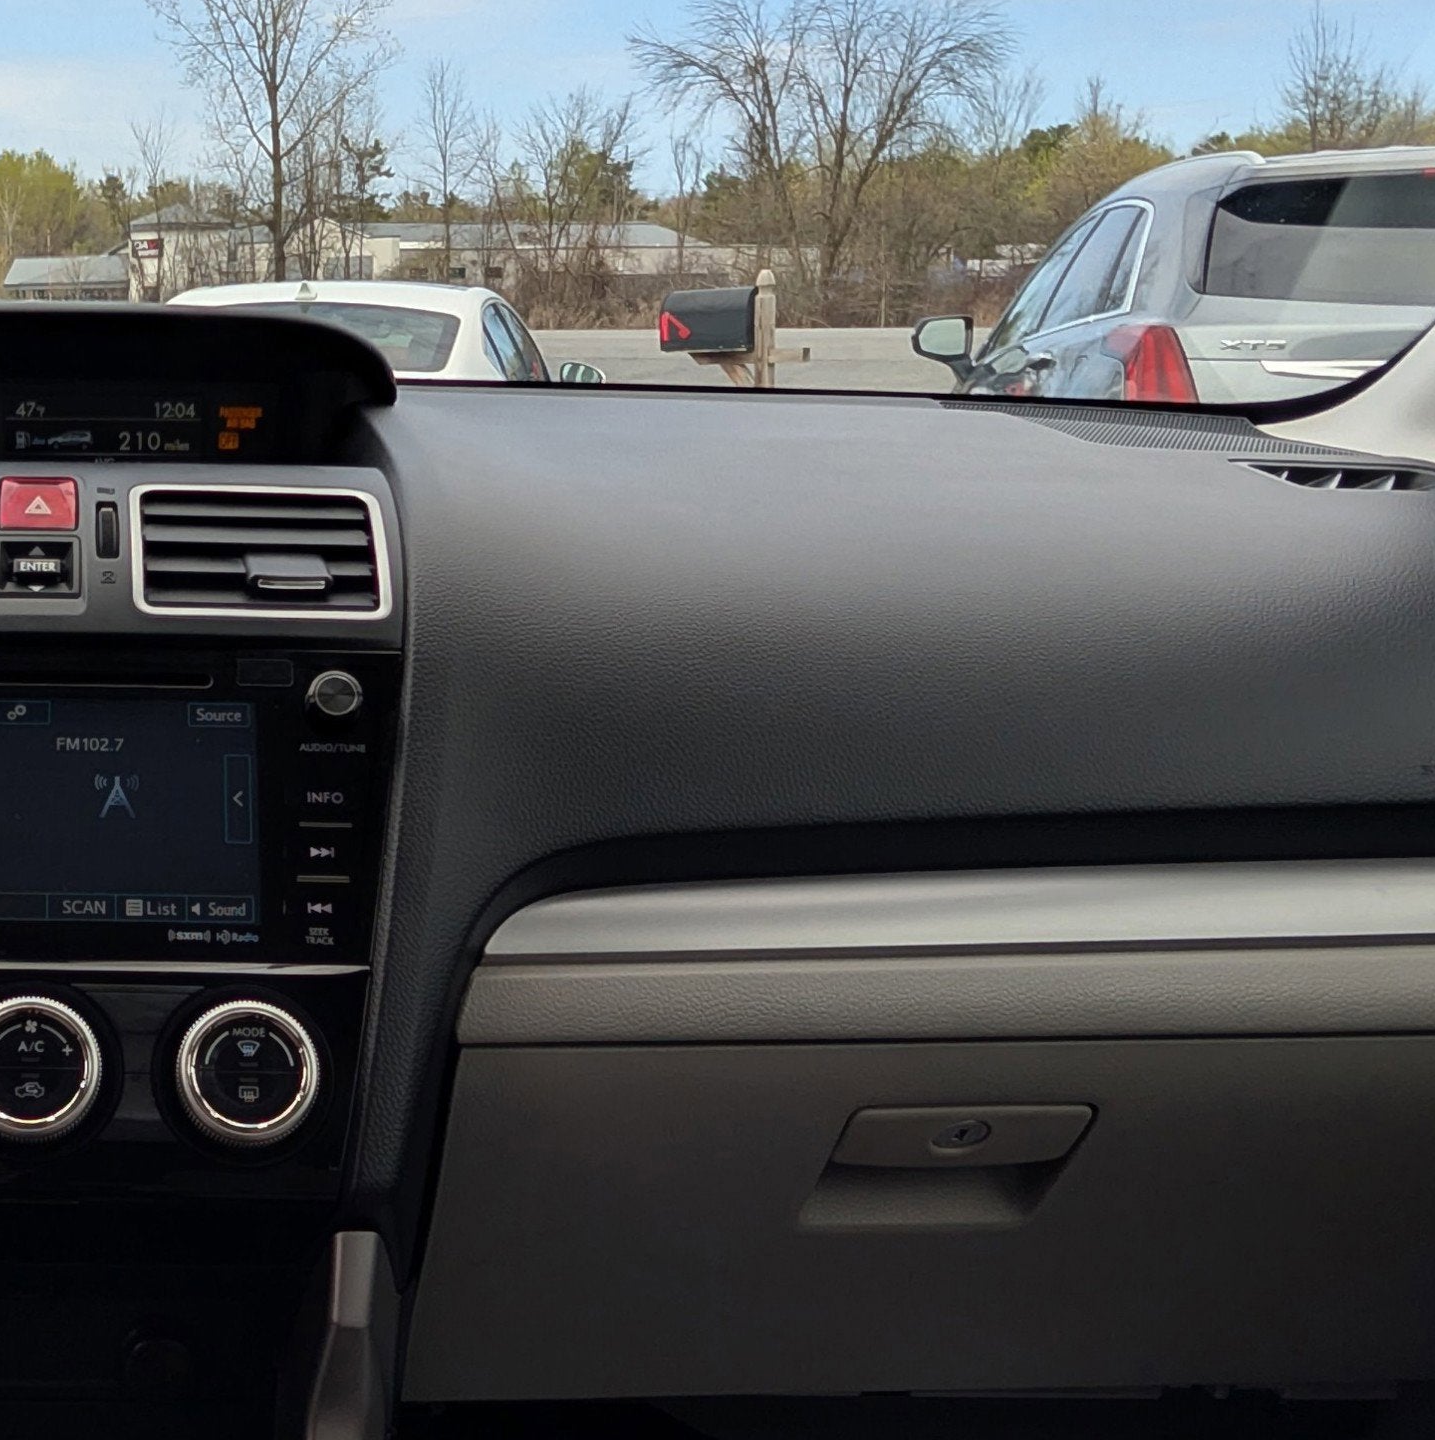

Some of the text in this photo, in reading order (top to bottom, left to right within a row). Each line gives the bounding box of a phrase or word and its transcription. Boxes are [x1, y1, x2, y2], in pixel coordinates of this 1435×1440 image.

[118, 431, 161, 451] 210
[20, 561, 55, 572] ENTER
[196, 708, 242, 723] Source
[299, 741, 366, 754] AUDIO/TUNE
[306, 791, 344, 804] INFO
[62, 900, 246, 917] SCAN List Sound
[232, 1027, 266, 1039] MODE
[17, 1039, 45, 1054] A/C
